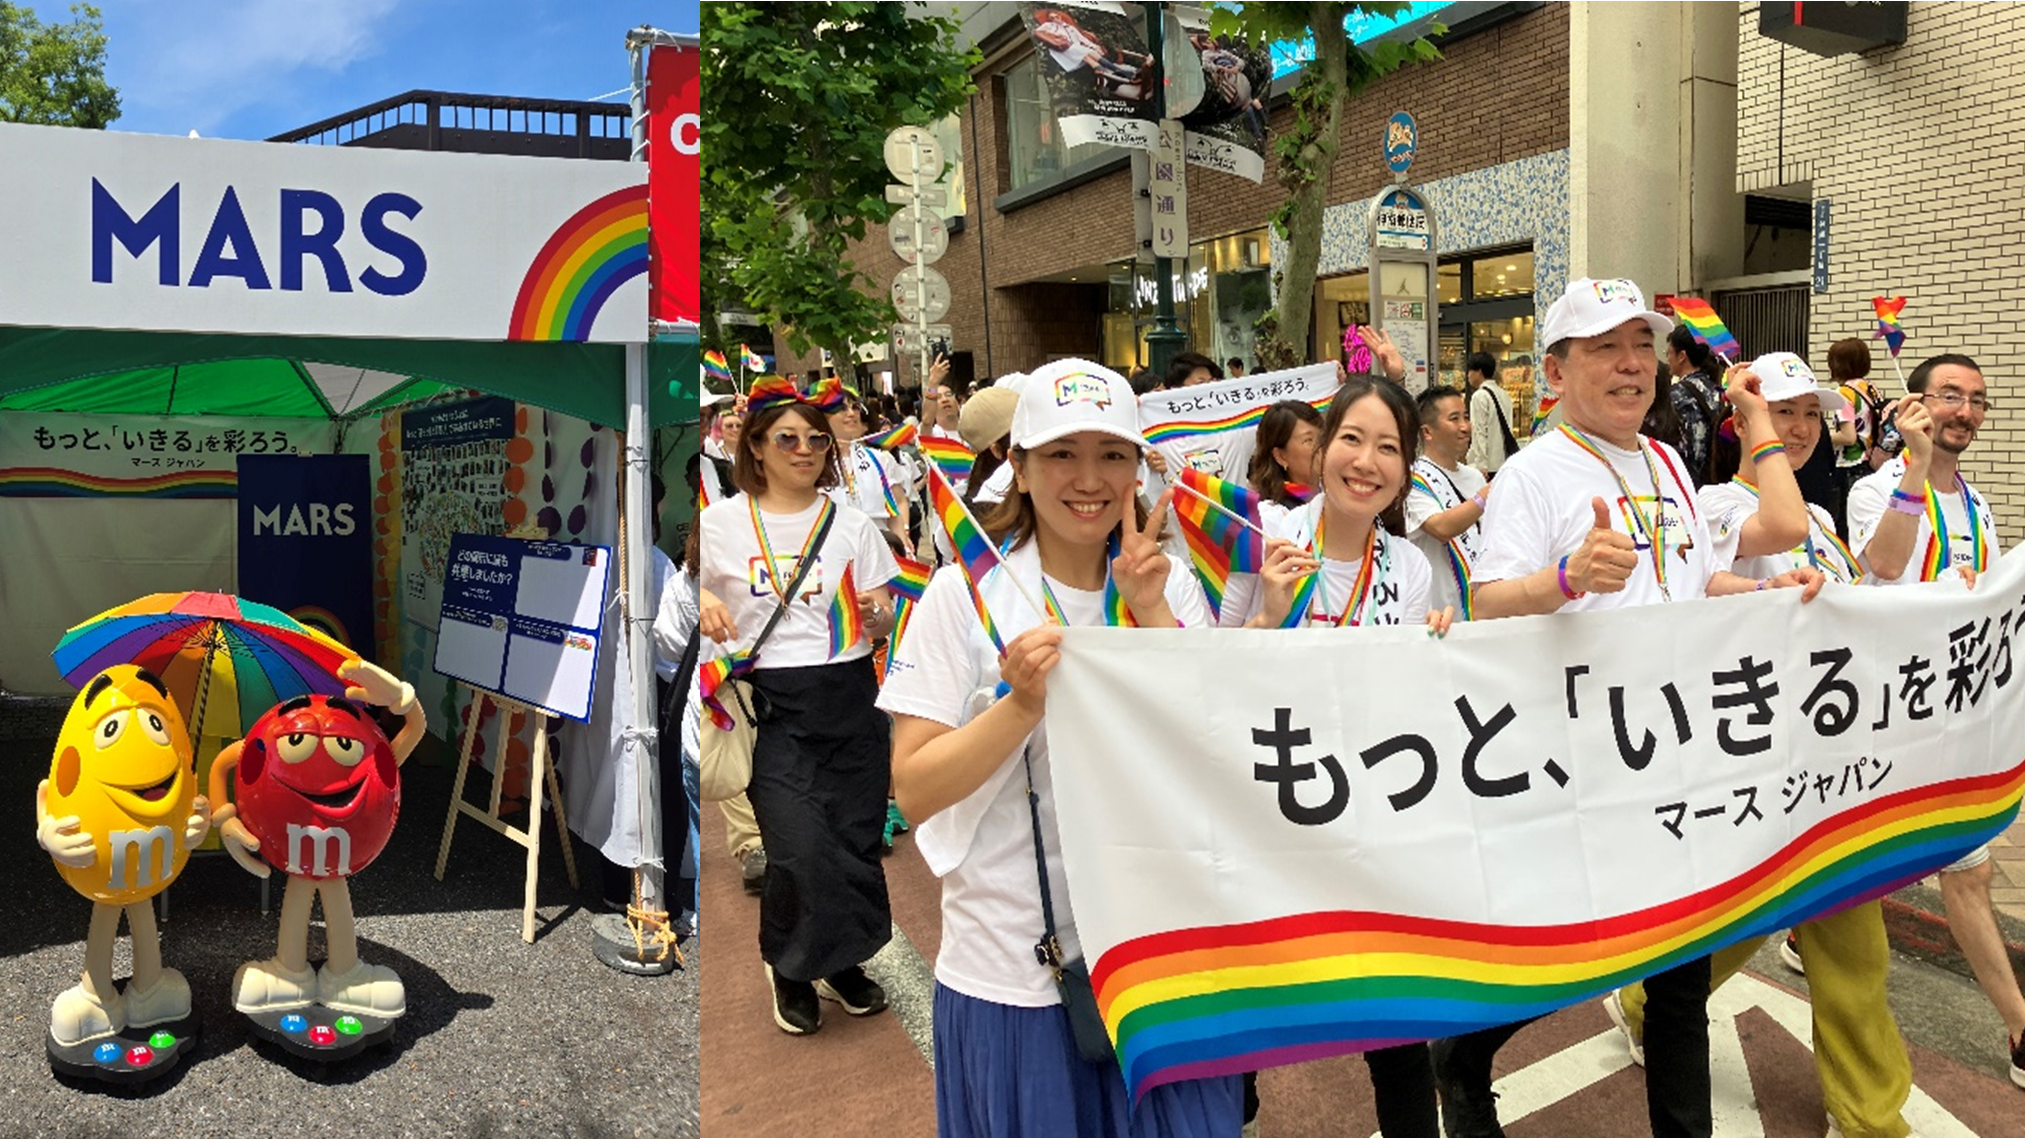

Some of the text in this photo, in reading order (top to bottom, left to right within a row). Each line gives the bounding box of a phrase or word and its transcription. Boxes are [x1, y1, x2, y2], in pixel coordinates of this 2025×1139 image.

[92, 176, 427, 296] MARS
[34, 425, 298, 454] もっと、「いきる」を彩ろう。
[131, 457, 205, 468] マース ジャパン
[253, 502, 356, 536] MARS
[1655, 757, 1892, 840] マース ジャパン
[107, 825, 174, 889] m
[286, 823, 351, 876] m
